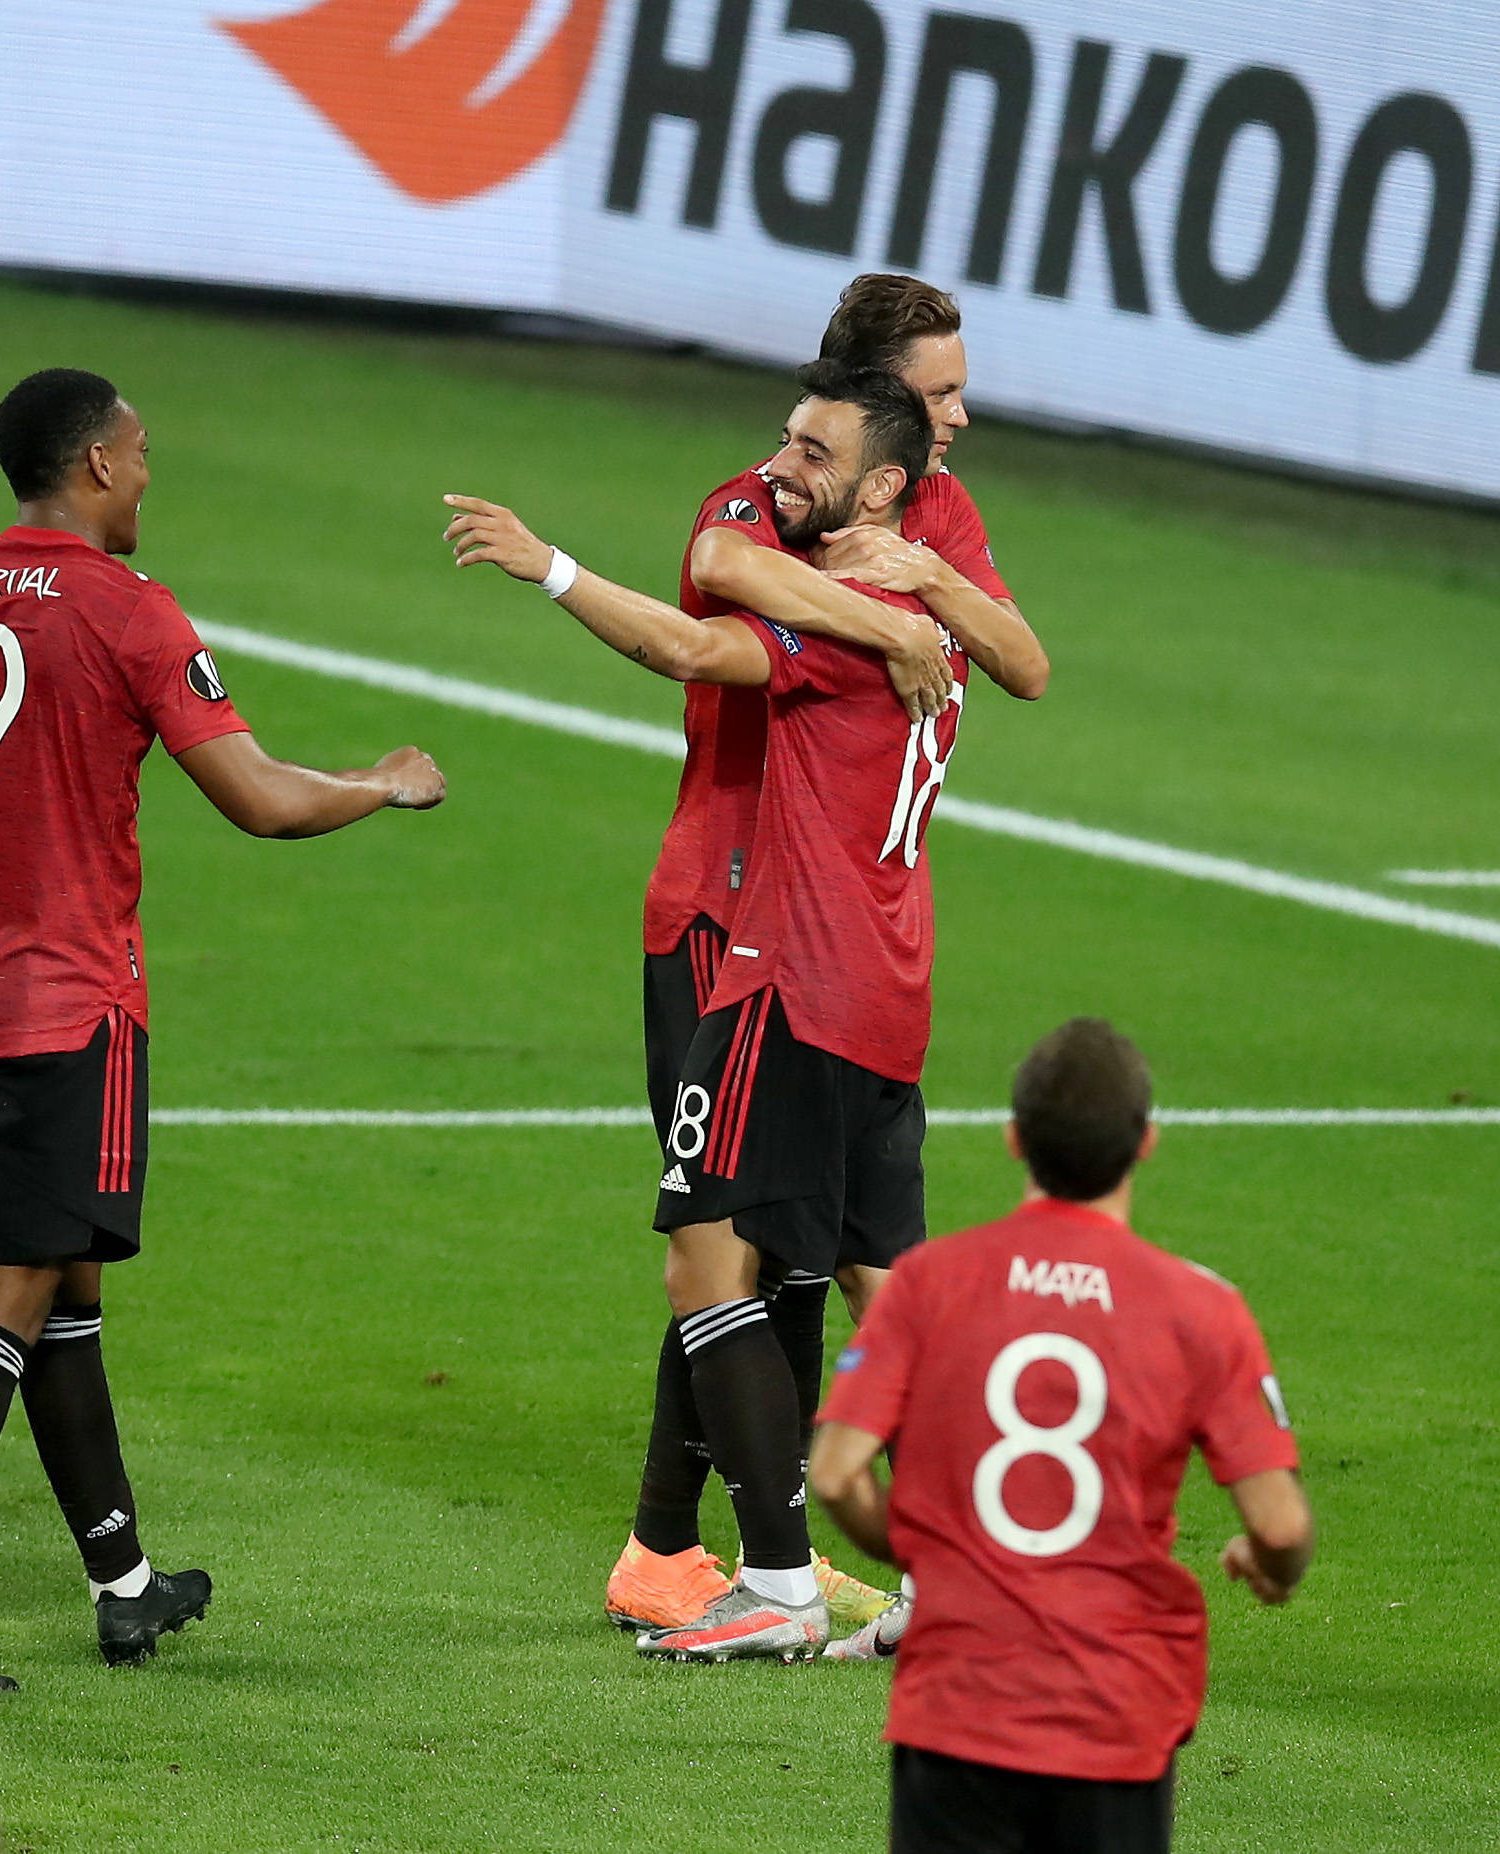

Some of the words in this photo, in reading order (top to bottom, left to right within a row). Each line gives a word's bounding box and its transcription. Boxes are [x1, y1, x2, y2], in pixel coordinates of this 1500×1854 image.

[878, 680, 964, 869] 18
[660, 1179, 691, 1194] adidas
[1008, 1255, 1115, 1313] MATA
[973, 1332, 1108, 1558] 8
